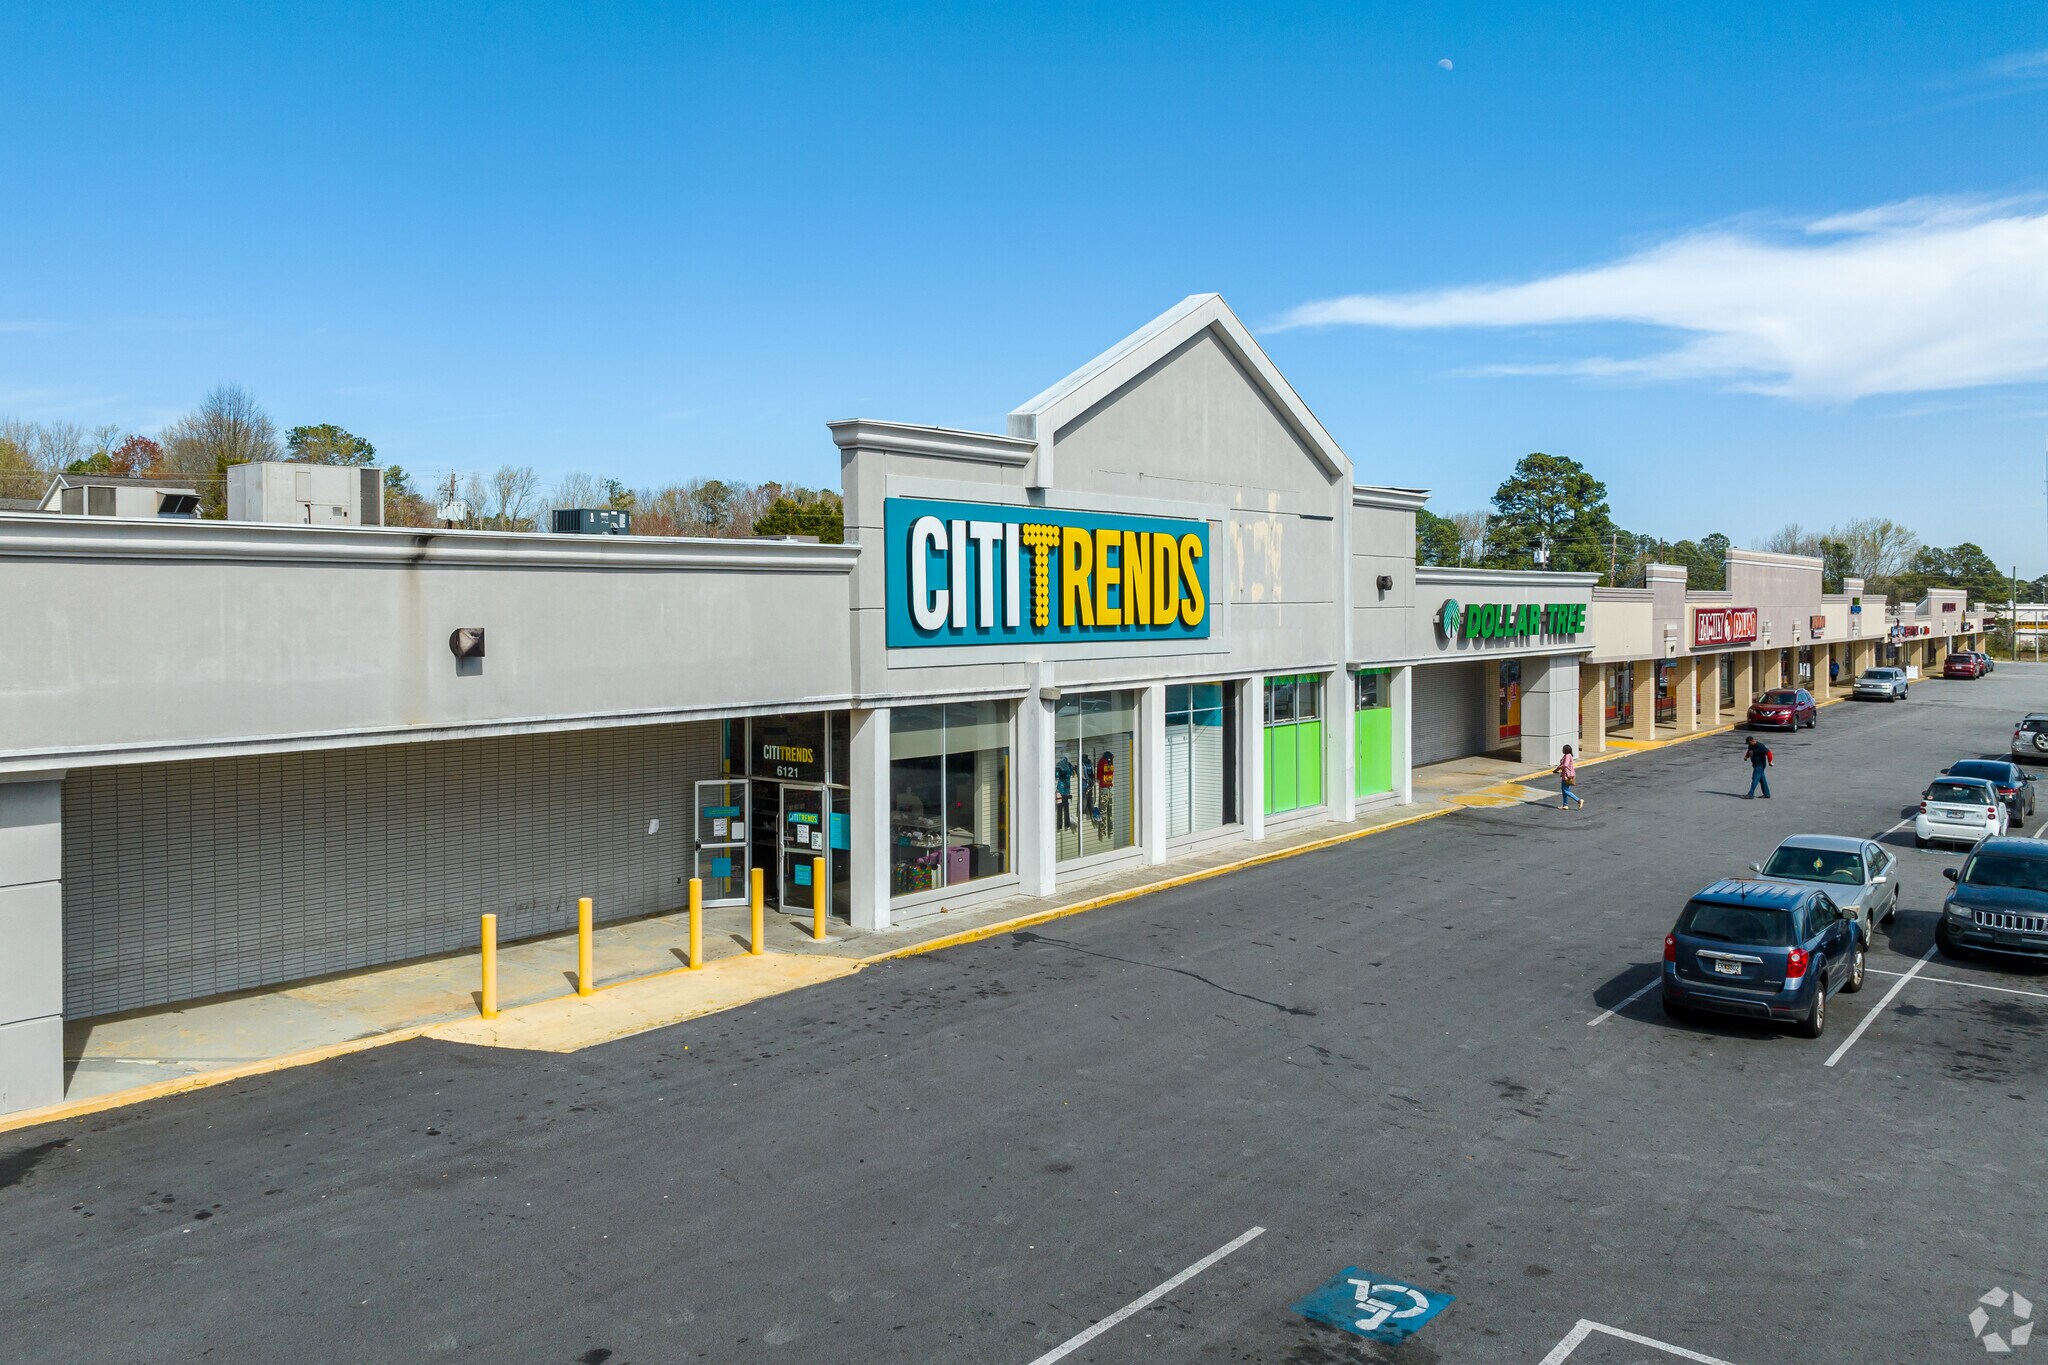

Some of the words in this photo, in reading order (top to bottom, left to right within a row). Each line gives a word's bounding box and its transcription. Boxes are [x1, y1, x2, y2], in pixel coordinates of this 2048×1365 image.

[1465, 603, 1541, 639] DOLLAR
[1547, 603, 1587, 635] TREE
[776, 765, 798, 778] 6121
